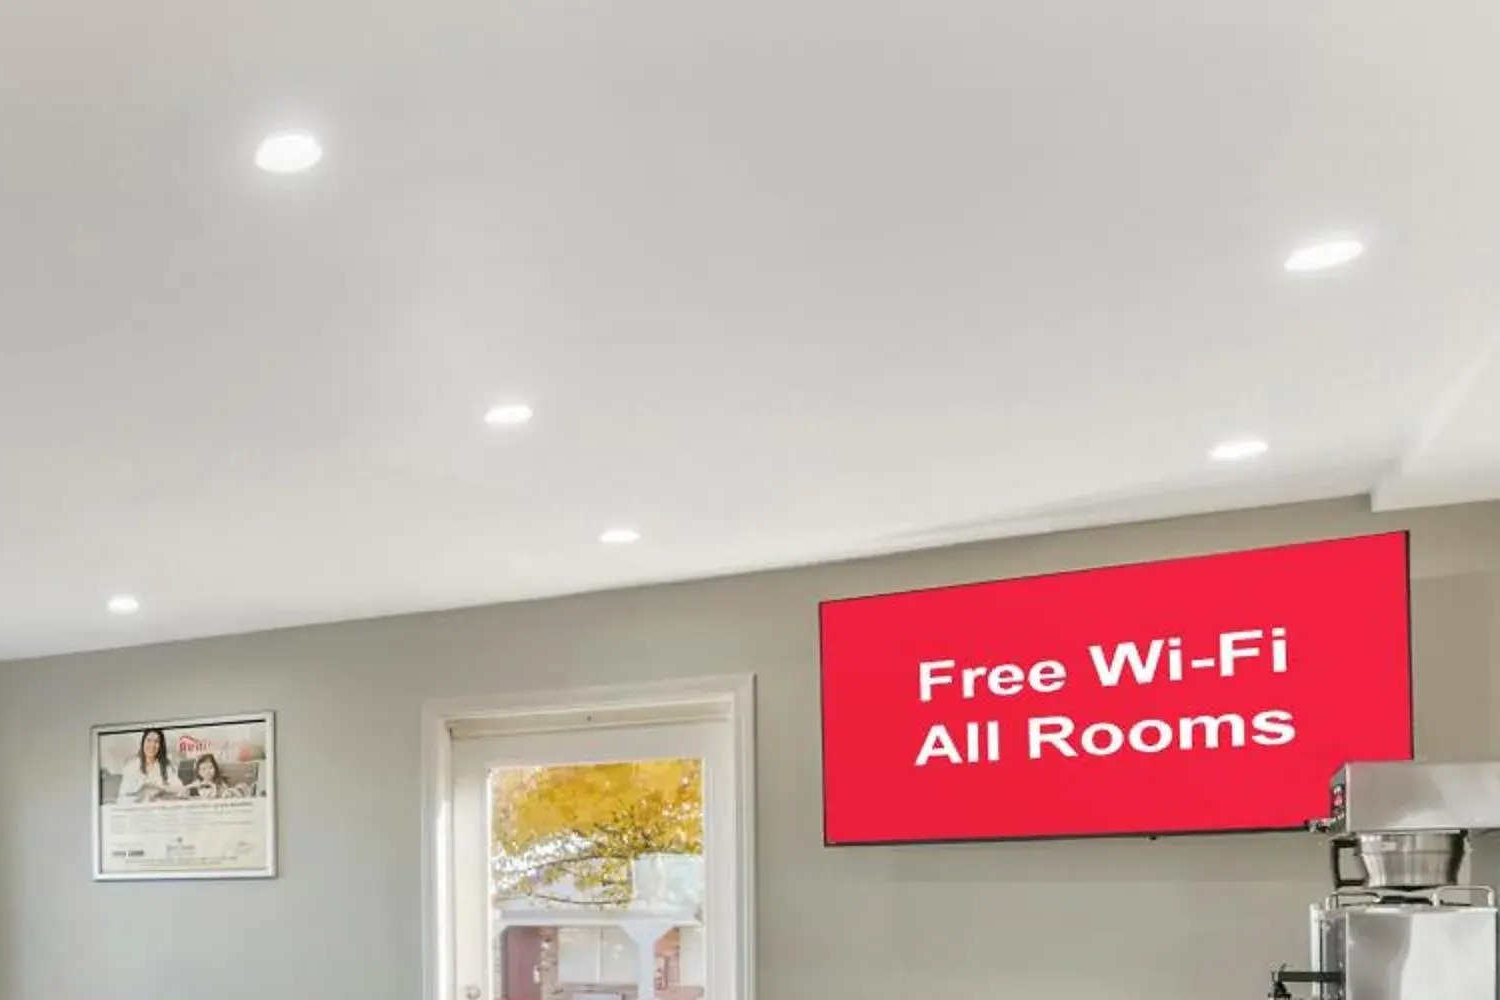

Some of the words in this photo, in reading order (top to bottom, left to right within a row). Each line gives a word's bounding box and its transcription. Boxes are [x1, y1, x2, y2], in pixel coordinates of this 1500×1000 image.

[920, 660, 1066, 701] Free
[1090, 628, 1286, 686] Wi-Fi
[916, 722, 999, 765] All
[1029, 711, 1295, 758] Rooms
